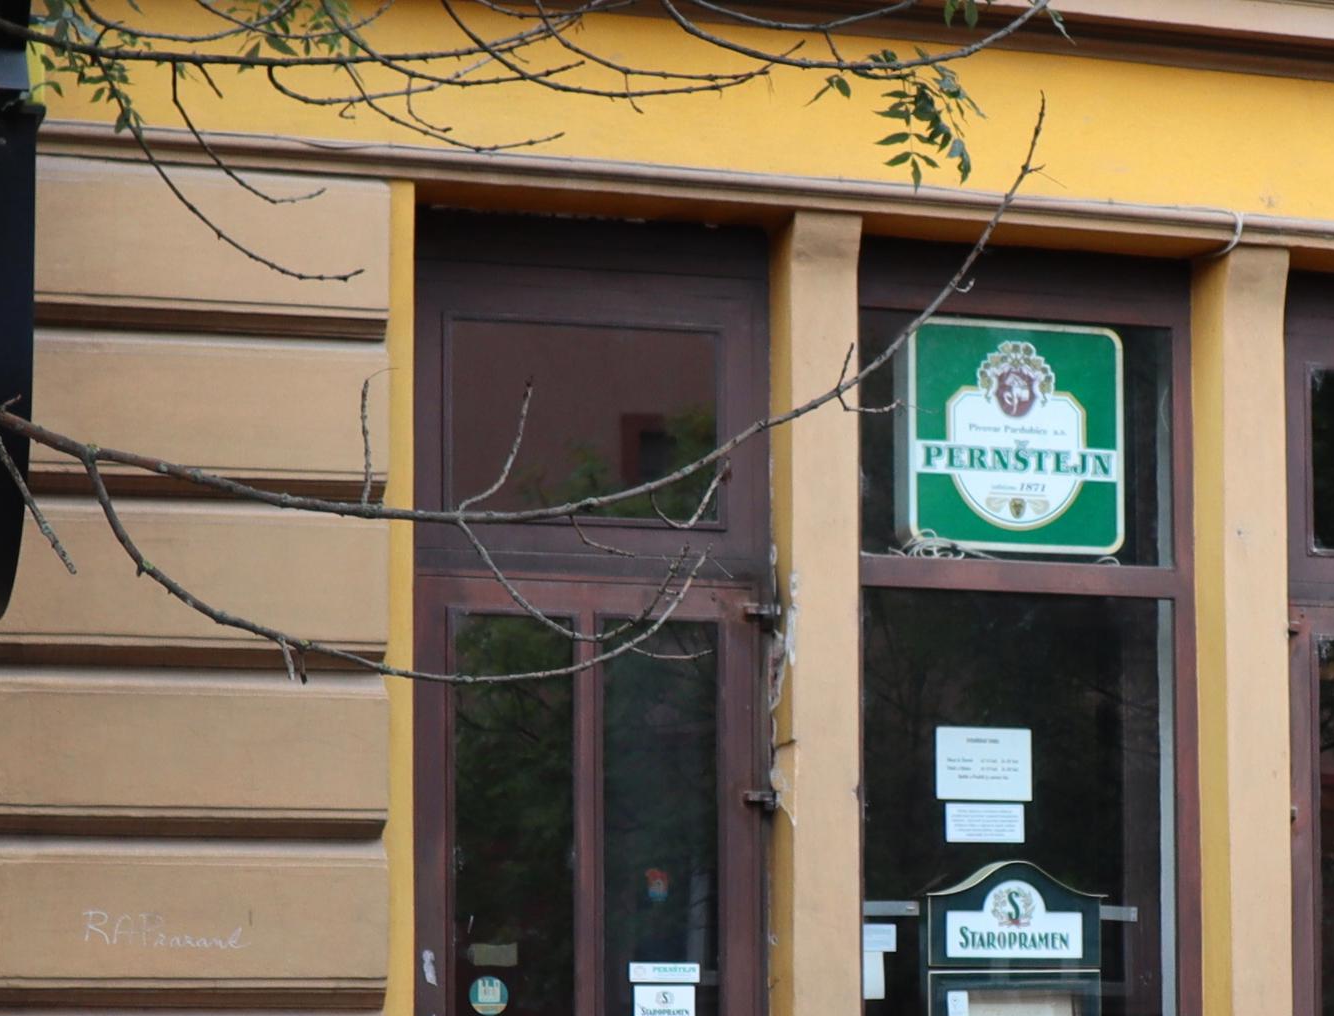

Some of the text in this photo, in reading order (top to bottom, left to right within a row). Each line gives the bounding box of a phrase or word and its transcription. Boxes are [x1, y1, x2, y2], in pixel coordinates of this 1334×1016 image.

[922, 440, 1112, 477] PERNŠTEJN
[1020, 483, 1046, 492] 1871
[959, 926, 1069, 950] STAROPRAMEN
